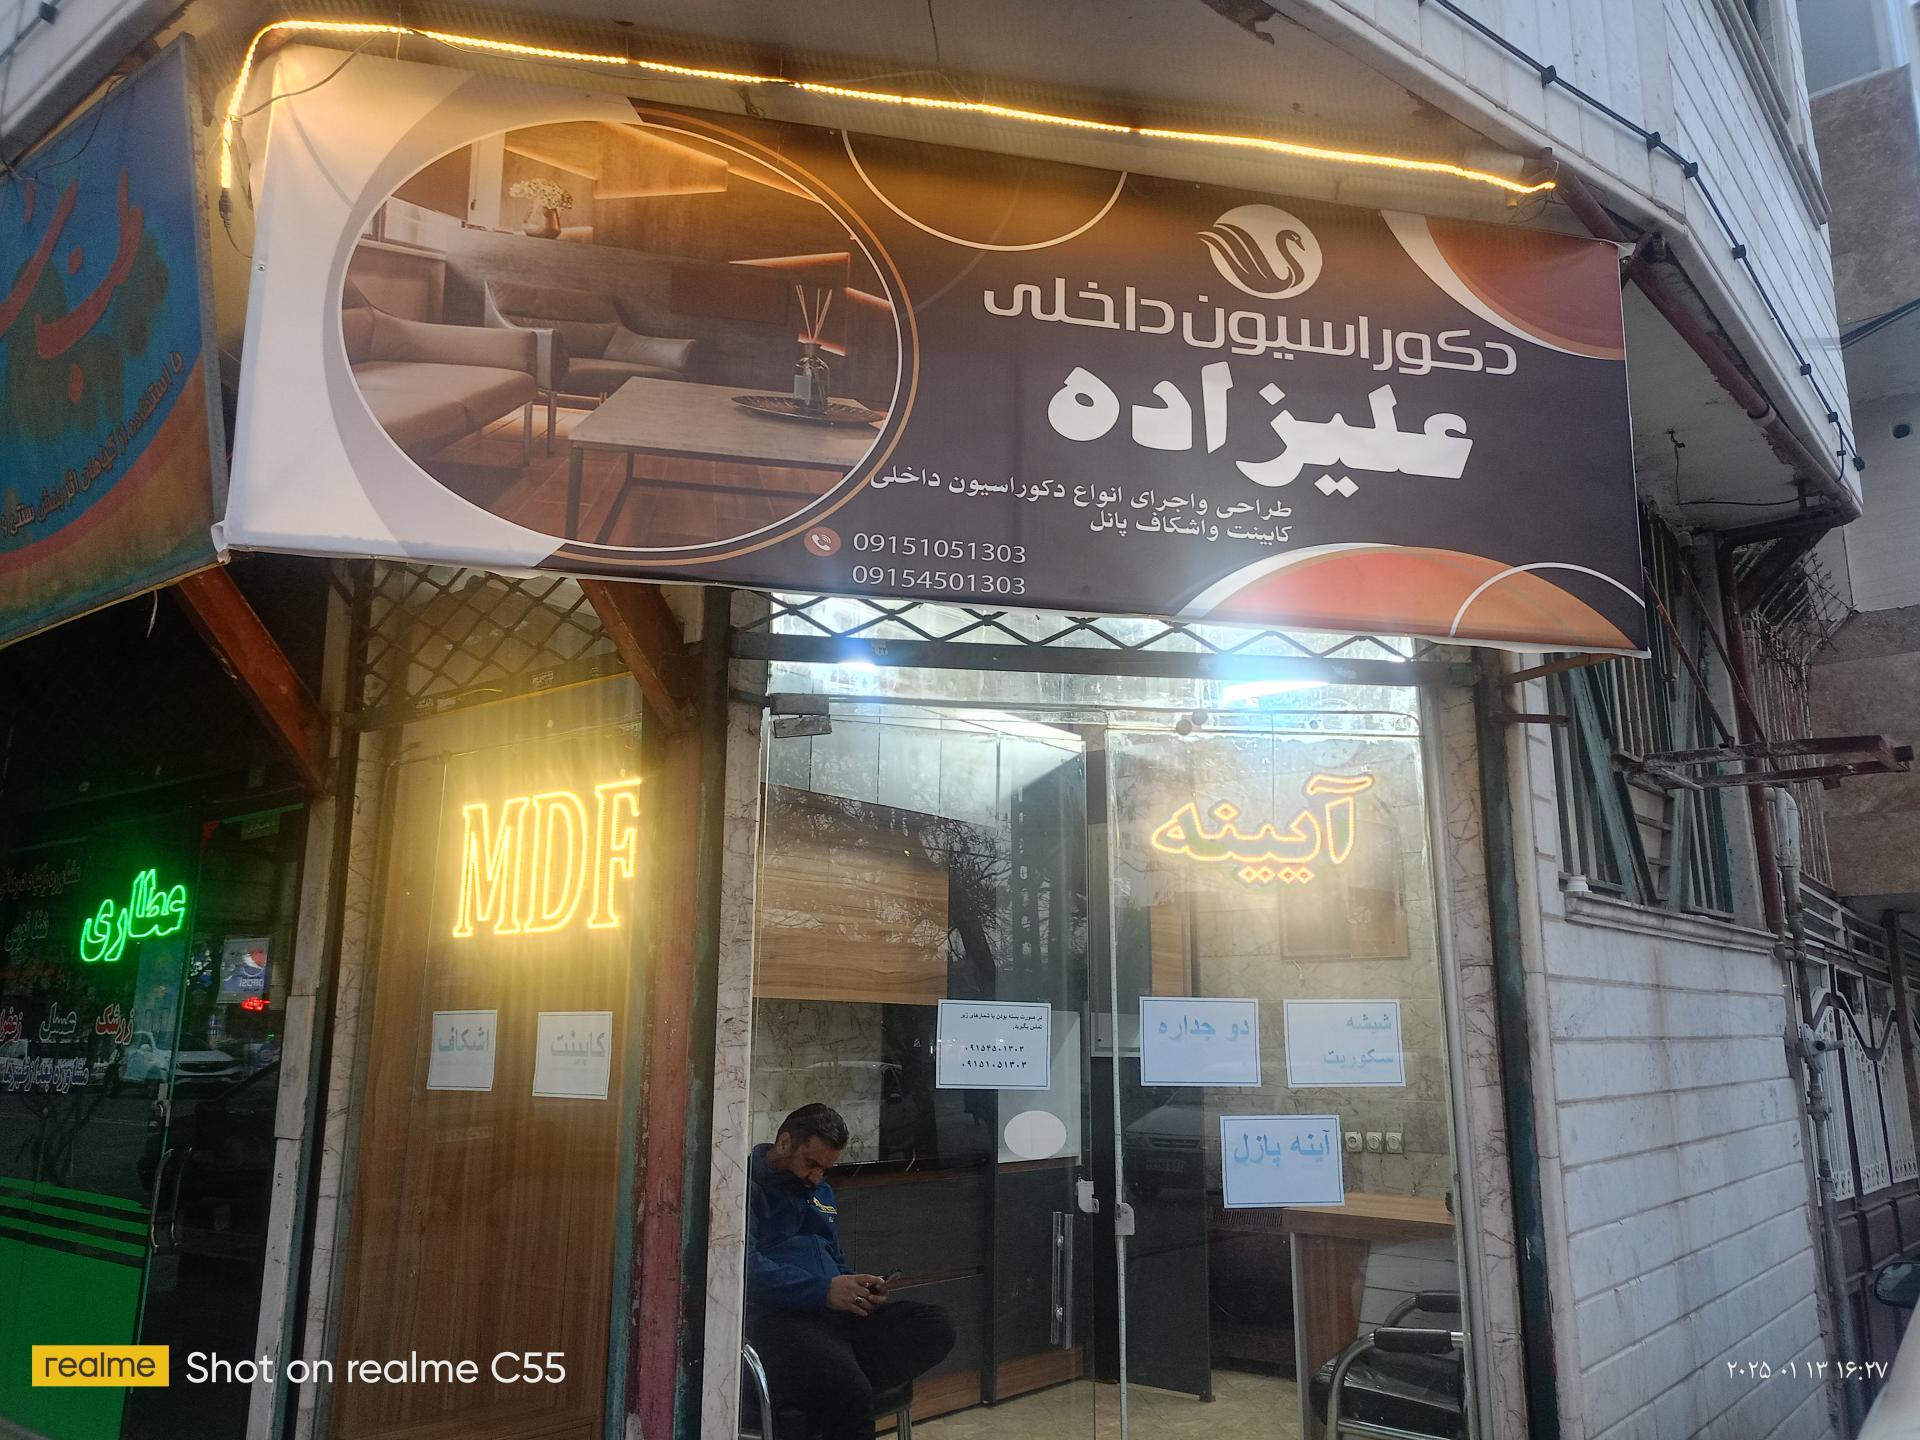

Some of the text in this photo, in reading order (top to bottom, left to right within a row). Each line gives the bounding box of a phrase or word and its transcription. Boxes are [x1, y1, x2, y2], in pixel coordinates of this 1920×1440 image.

[983, 276, 1519, 376] دکوراسیون داخلی
[1047, 361, 1475, 498] علیزاده
[870, 465, 941, 489] داخلی
[948, 475, 1067, 502] دکوراسیون
[1073, 486, 1123, 508] انواع
[1215, 498, 1293, 520] طراحی
[1090, 509, 1128, 537] پانل
[1226, 524, 1293, 546] کابینت
[852, 532, 1027, 564] 09151051303
[851, 565, 1027, 595] 09154501303
[452, 777, 643, 939] MDF
[80, 868, 187, 963] عطاری
[95, 1003, 134, 1045] زرشک
[1158, 1015, 1250, 1041] دو جداره
[1345, 1013, 1393, 1034] شیشه
[437, 1026, 490, 1053] اشکاف
[550, 1031, 607, 1066] کابینت
[1323, 1048, 1394, 1069] سکوریت
[1232, 1129, 1332, 1167] آینه پازل
